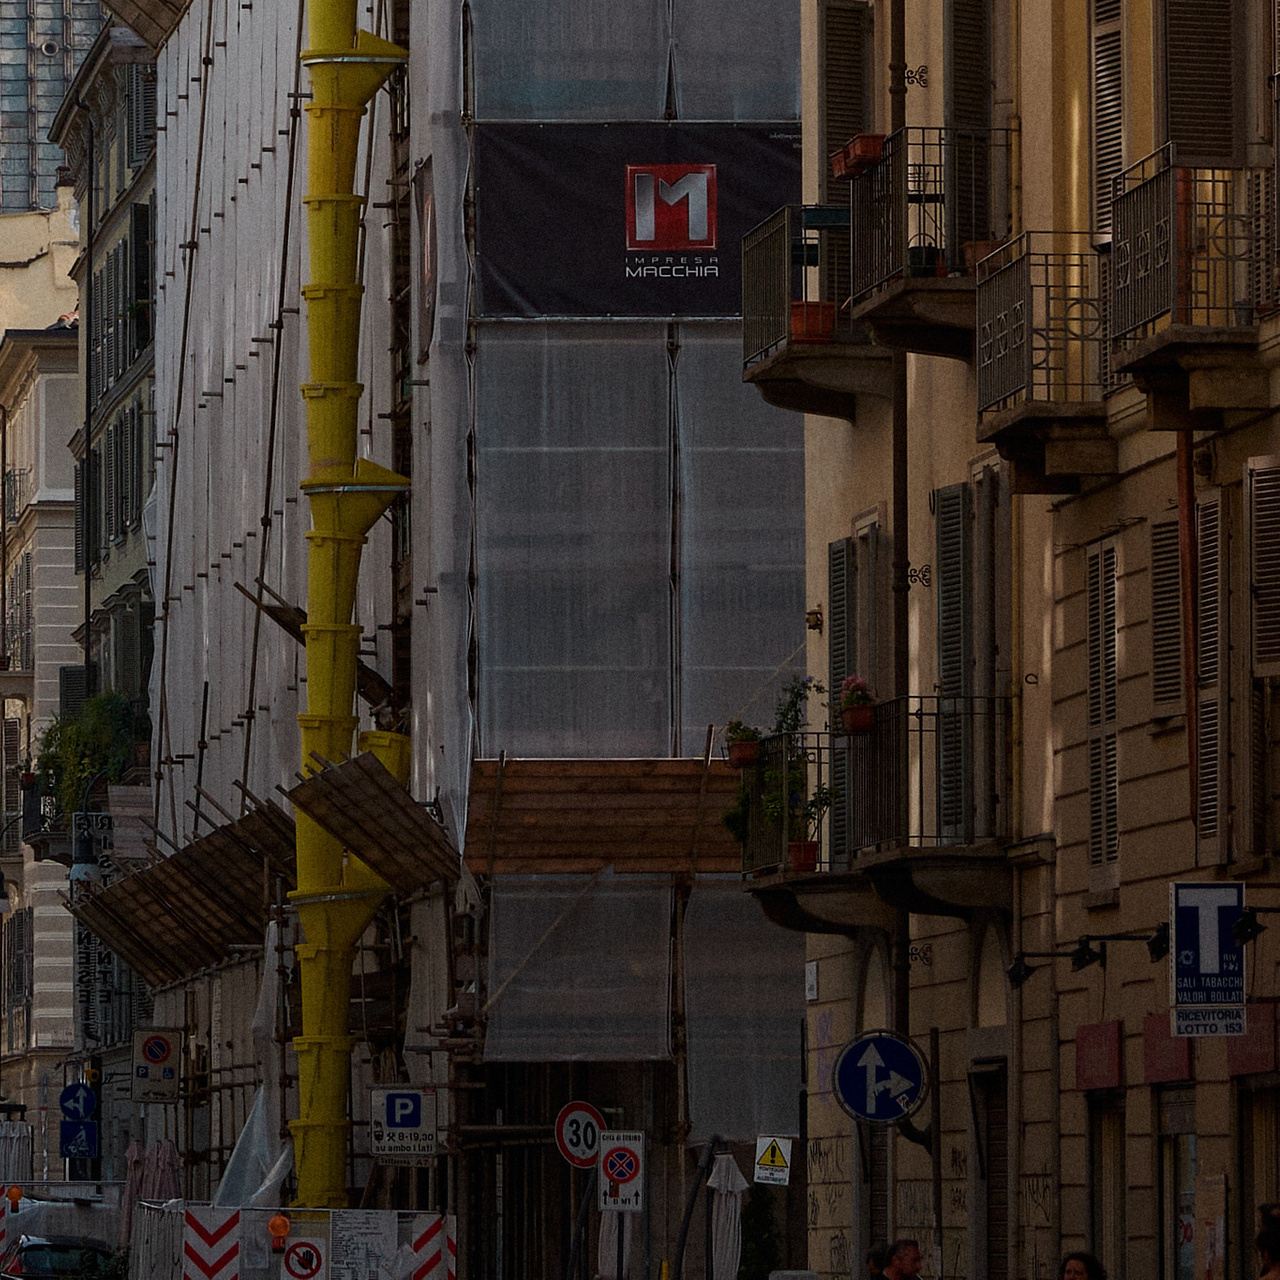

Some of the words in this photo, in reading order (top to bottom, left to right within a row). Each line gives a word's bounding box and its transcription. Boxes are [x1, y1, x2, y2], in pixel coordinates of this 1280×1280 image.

[625, 256, 719, 264] IMPRESA
[625, 266, 719, 278] MACCHIA
[1178, 888, 1238, 974] T
[1176, 977, 1197, 988] SALI
[1200, 977, 1243, 988] TABACCHI
[1177, 991, 1207, 1003] VALORI
[1211, 990, 1243, 1002] BOLLATI
[1177, 1010, 1242, 1022] RICEVITORIA
[1177, 1024, 1218, 1035] LOTTO
[1224, 1023, 1242, 1033] 153
[138, 1067, 147, 1077] P
[394, 1097, 414, 1124] P
[568, 1118, 597, 1150] 30
[388, 1144, 411, 1152] ambo
